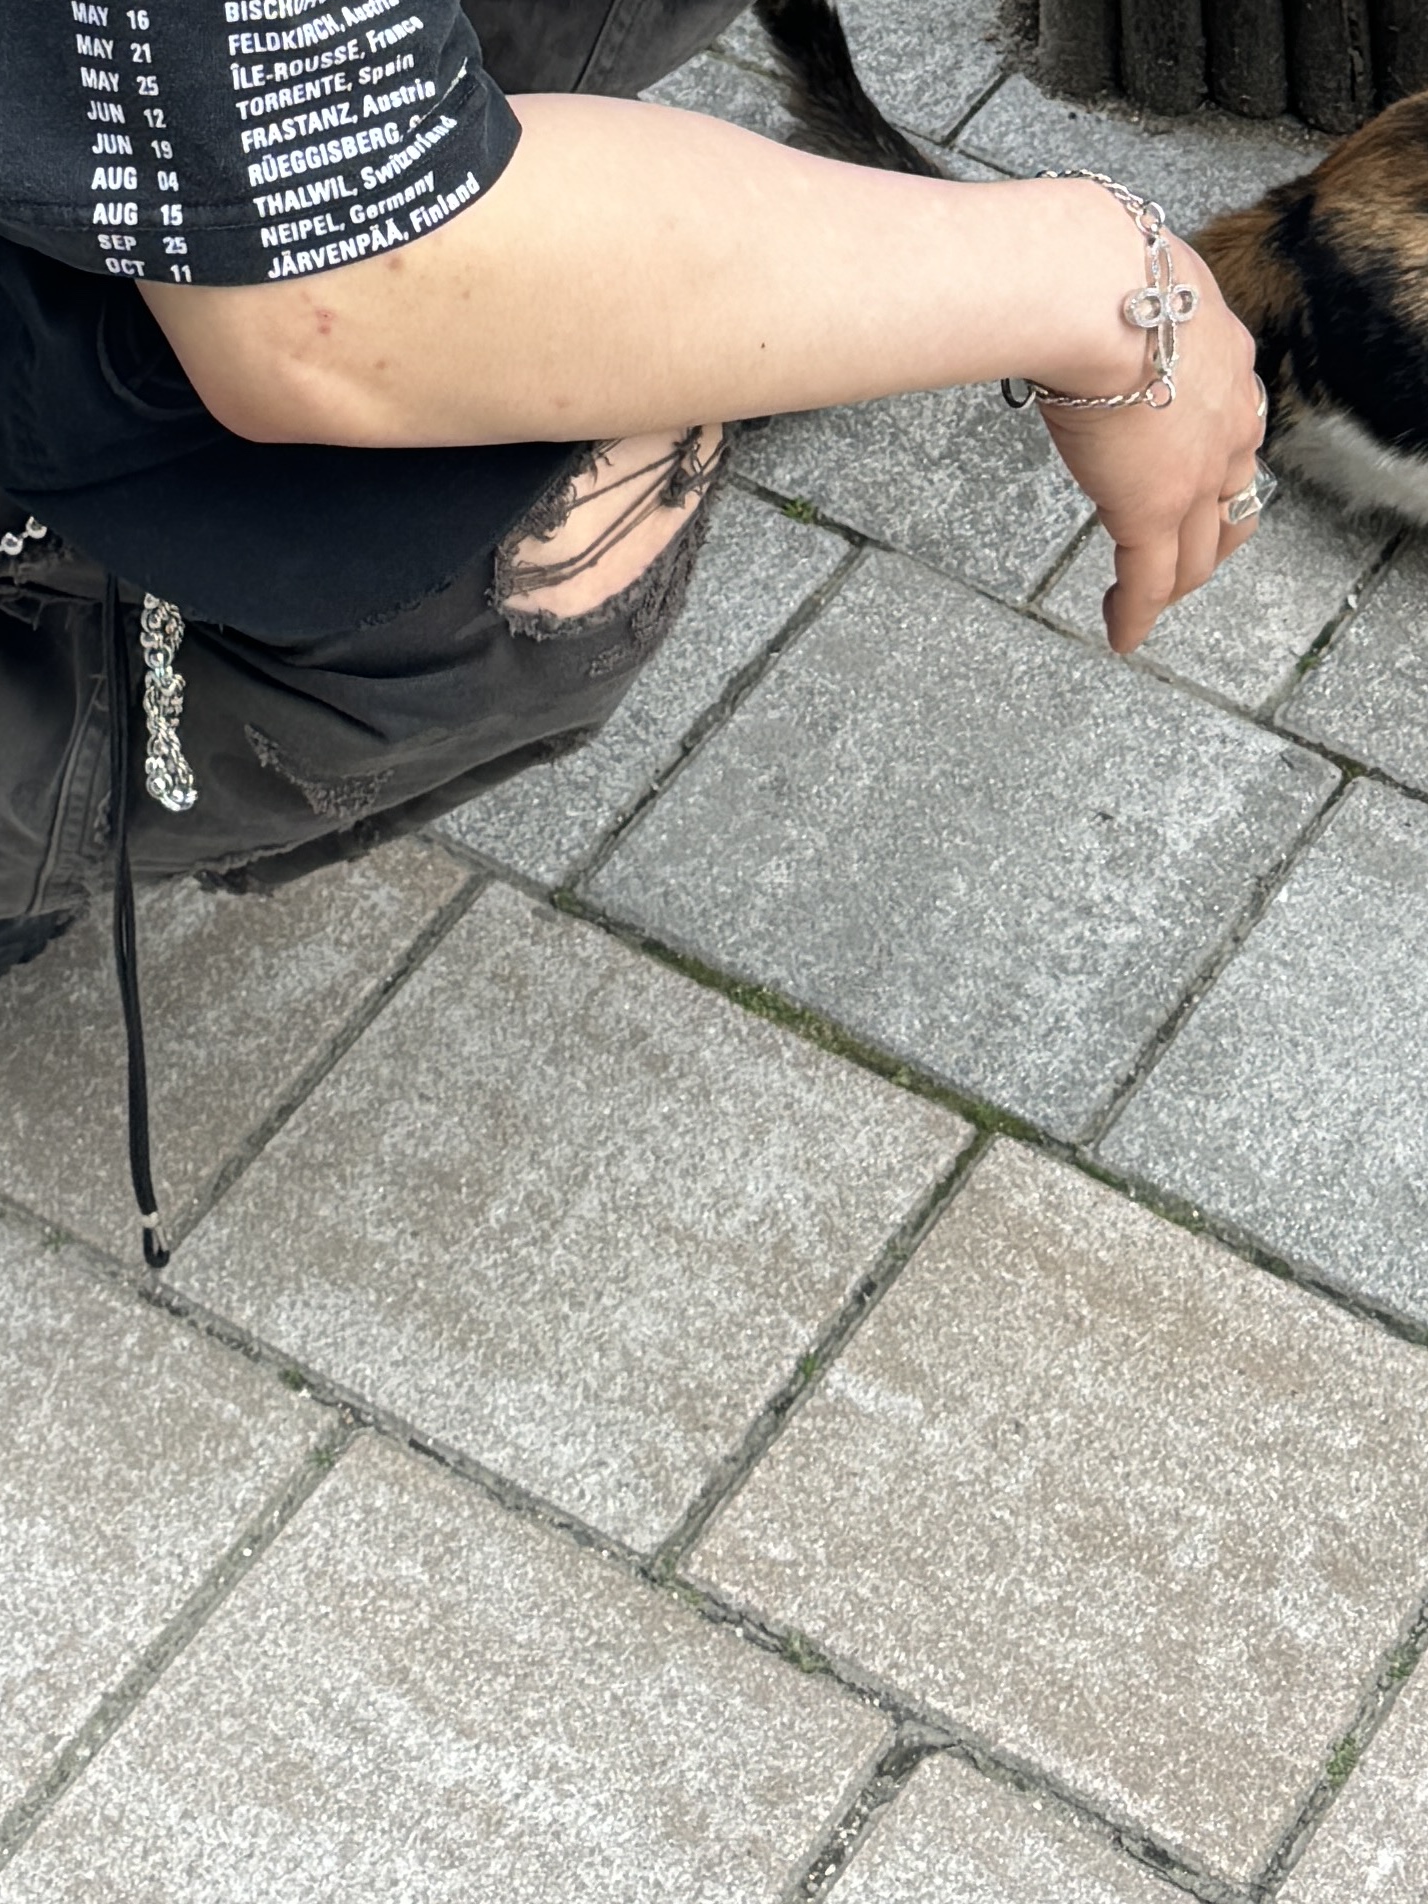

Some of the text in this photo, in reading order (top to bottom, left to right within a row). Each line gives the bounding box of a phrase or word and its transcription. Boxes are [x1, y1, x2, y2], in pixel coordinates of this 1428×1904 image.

[71, 0, 109, 27] MAY
[126, 9, 150, 30] 16
[75, 33, 114, 60] MAY
[130, 42, 152, 64] 21
[228, 13, 345, 56] FELDKIRCH,
[80, 15, 424, 96] MAY 25 ÎLE-ROUSSE, France
[86, 53, 415, 129] JUN 12 TORRENTE, Spain
[91, 132, 133, 156] JUN
[150, 139, 173, 160] 19
[240, 101, 358, 154] FRASTANZ,
[362, 78, 436, 118] Austria
[91, 122, 404, 192] AUG 04 RÜEGGISBERG,
[92, 115, 458, 226] AUG 15 THALWIL, Switzerland
[97, 170, 435, 255] SEP 25 NEIPEL, Germany
[105, 171, 481, 283] OCT 11 JÄRVENPÄÄ, Finland
